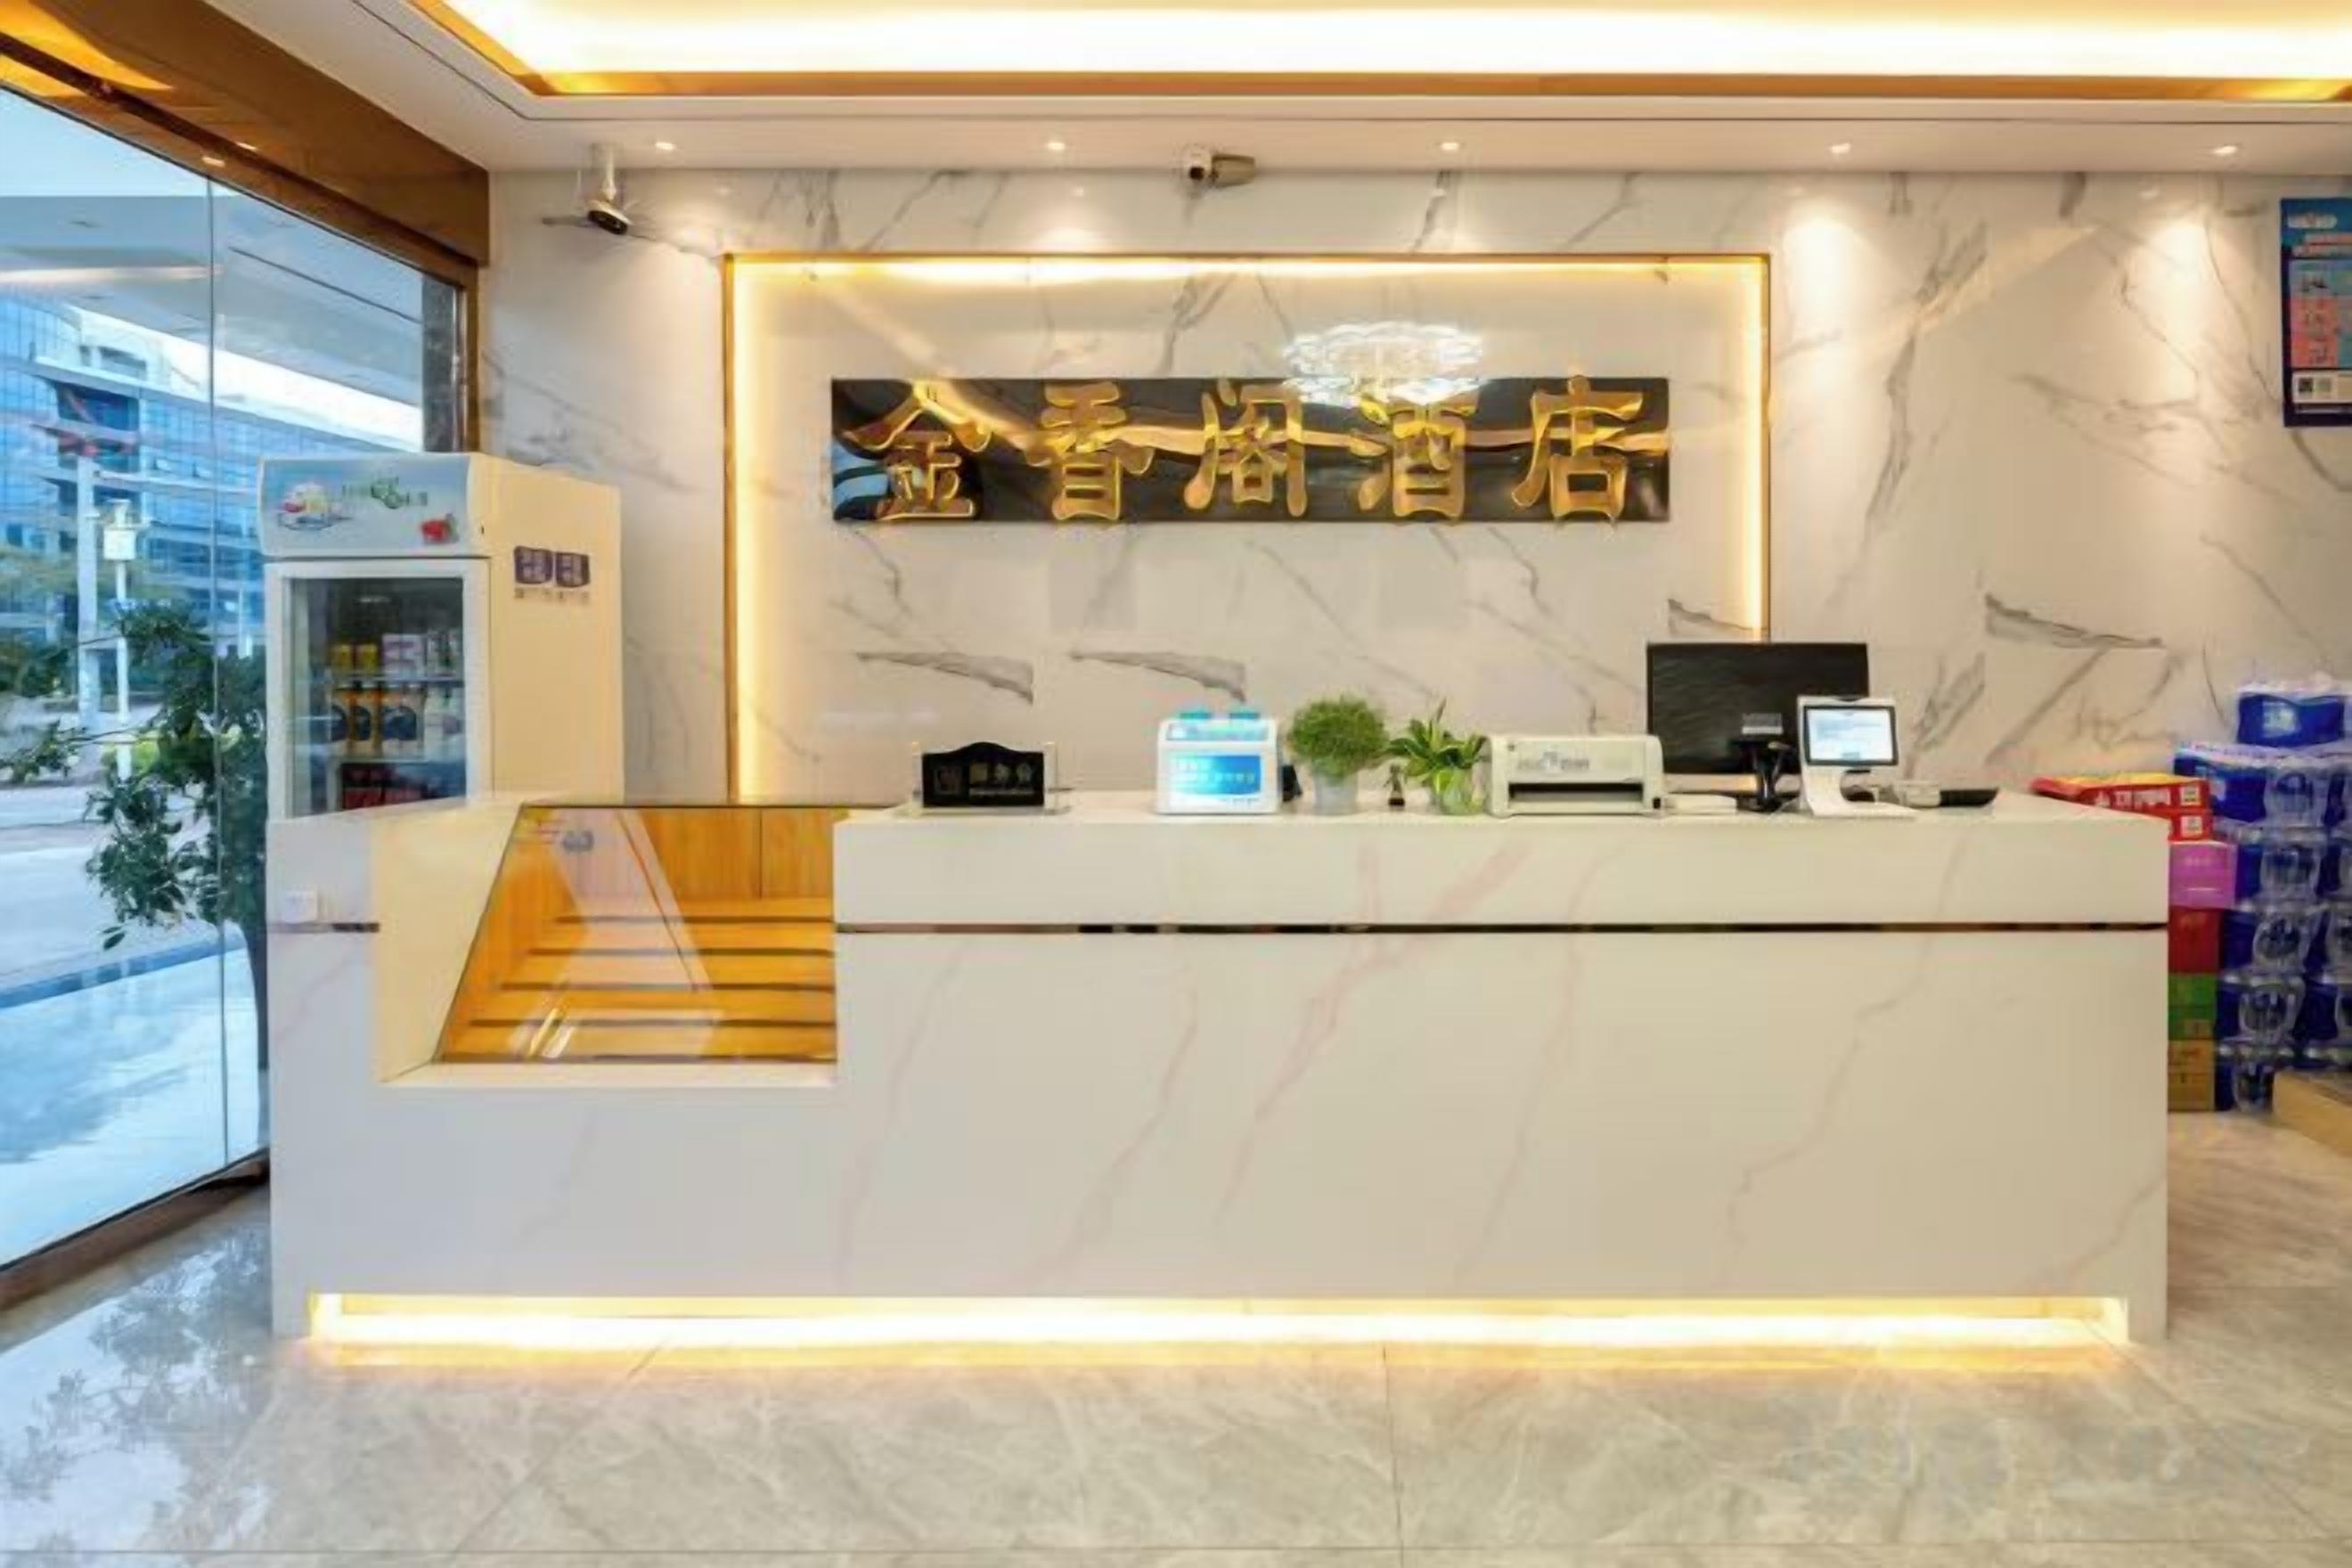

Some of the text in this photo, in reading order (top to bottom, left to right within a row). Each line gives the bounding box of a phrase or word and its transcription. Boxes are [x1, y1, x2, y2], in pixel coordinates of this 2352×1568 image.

[841, 375, 1647, 524] 金香阁酒店
